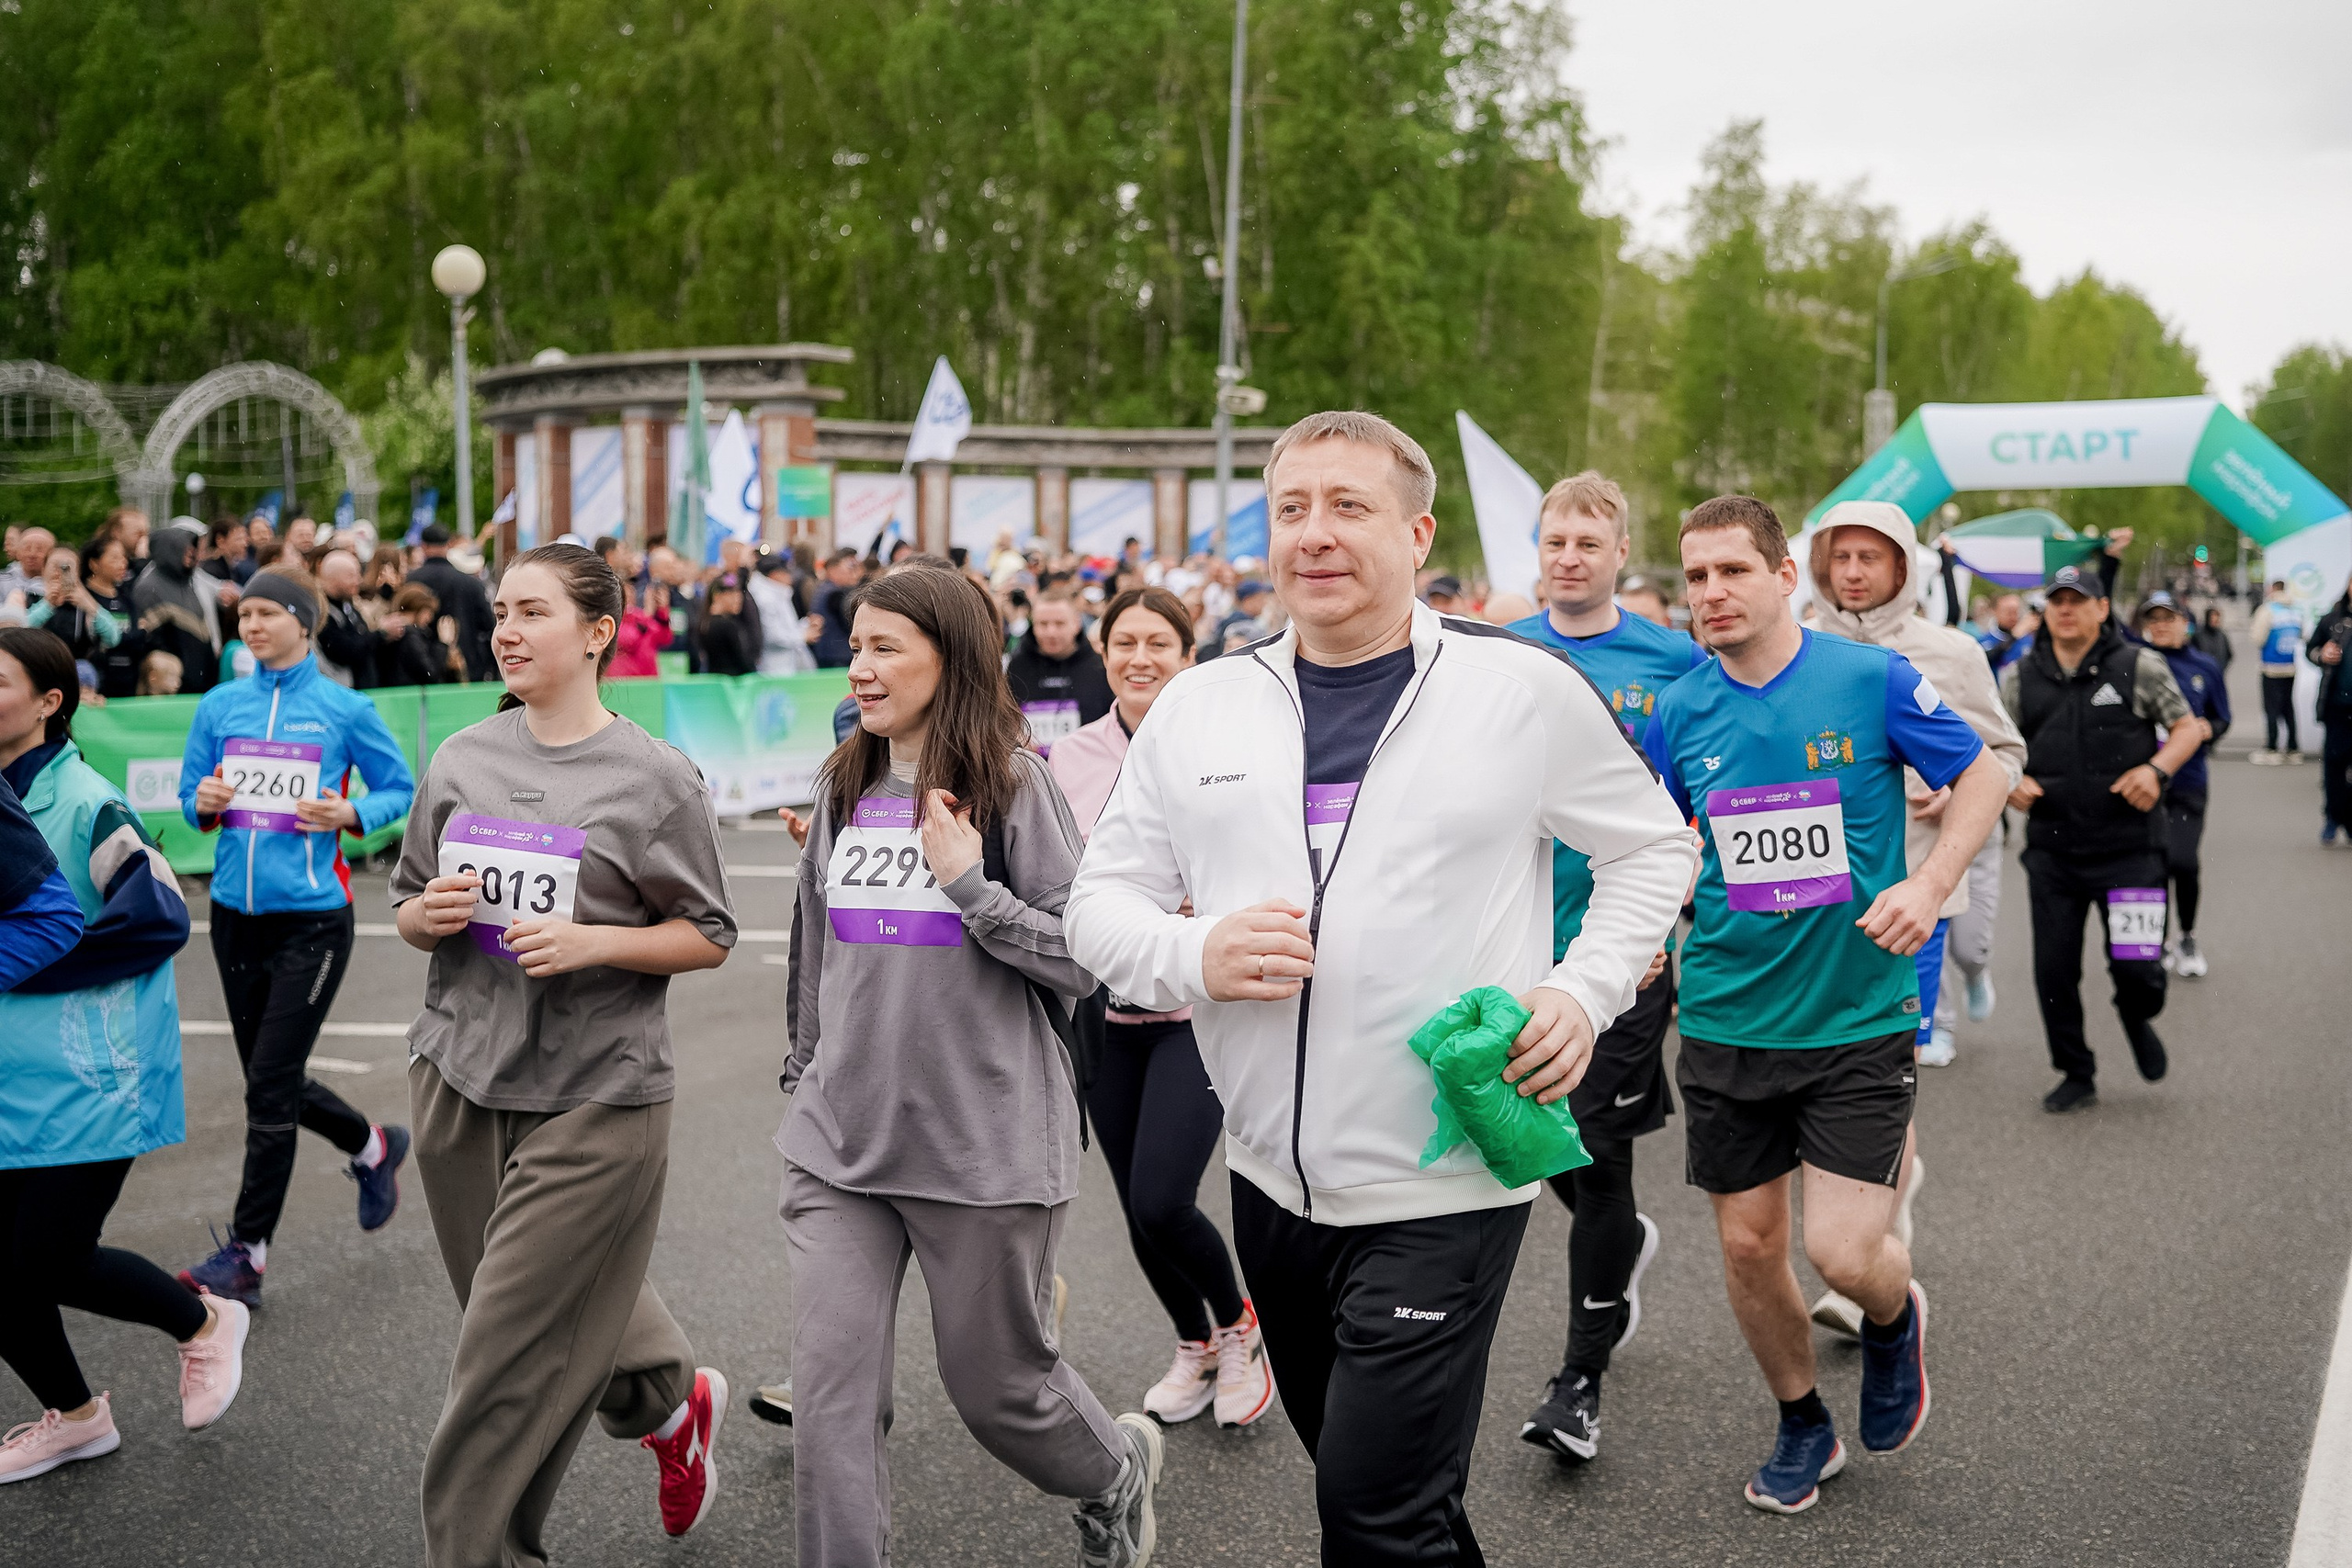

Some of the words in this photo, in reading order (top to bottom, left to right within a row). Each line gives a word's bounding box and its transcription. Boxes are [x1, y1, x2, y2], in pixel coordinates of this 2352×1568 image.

[1990, 429, 2139, 464] СТАРТ
[232, 770, 306, 800] 2260
[1214, 773, 1247, 784] SPORT
[478, 827, 498, 837] СБЕР
[1732, 824, 1830, 865] 2080
[458, 863, 557, 914] 013
[1393, 1307, 1413, 1318] 2K
[1411, 1310, 1447, 1321] SPORT
